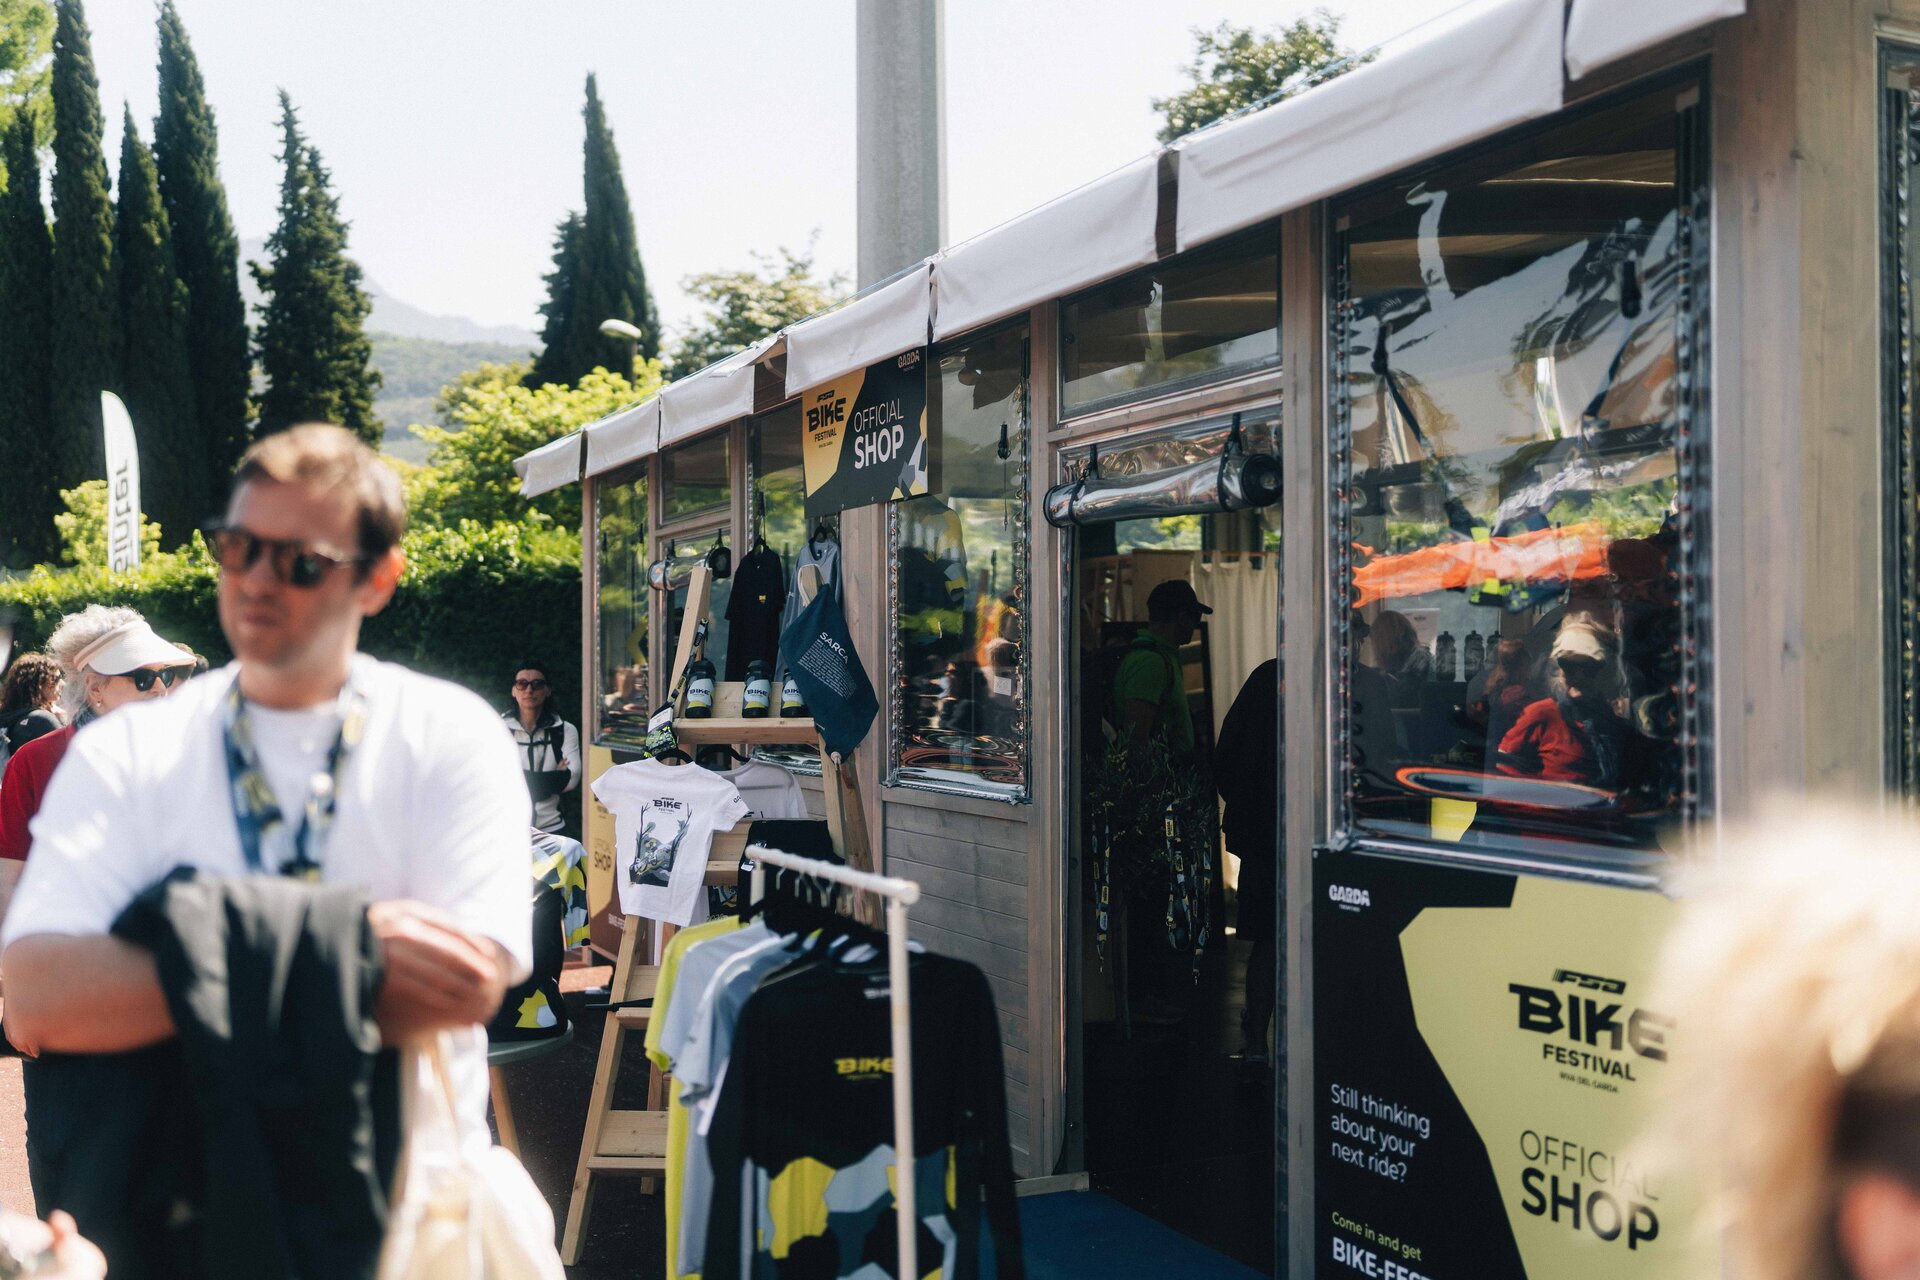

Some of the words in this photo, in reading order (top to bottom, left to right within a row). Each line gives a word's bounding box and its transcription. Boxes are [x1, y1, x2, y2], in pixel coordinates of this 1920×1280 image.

[898, 350, 920, 368] GARDA
[806, 397, 846, 432] BIKE
[854, 398, 904, 433] OFFICIAL
[814, 428, 837, 442] FESTIVAL
[854, 424, 904, 469] SHOP
[819, 631, 849, 664] SARCA
[653, 799, 682, 809] BIKE
[1328, 884, 1371, 907] GARDA
[1508, 982, 1677, 1063] BIKE
[1543, 1043, 1636, 1082] FESTIVAL
[1331, 1083, 1358, 1110] Still
[1362, 1094, 1430, 1139] thinking
[1331, 1113, 1376, 1144] about
[1379, 1131, 1416, 1157] your
[1332, 1142, 1365, 1168] next
[1368, 1152, 1407, 1183] ride?
[1521, 1167, 1659, 1251] SHOP
[1332, 1211, 1363, 1235] Come
[1365, 1223, 1375, 1241] in
[1378, 1233, 1399, 1251] and
[1402, 1244, 1422, 1262] get
[1332, 1236, 1432, 1280] BIKE-FE
